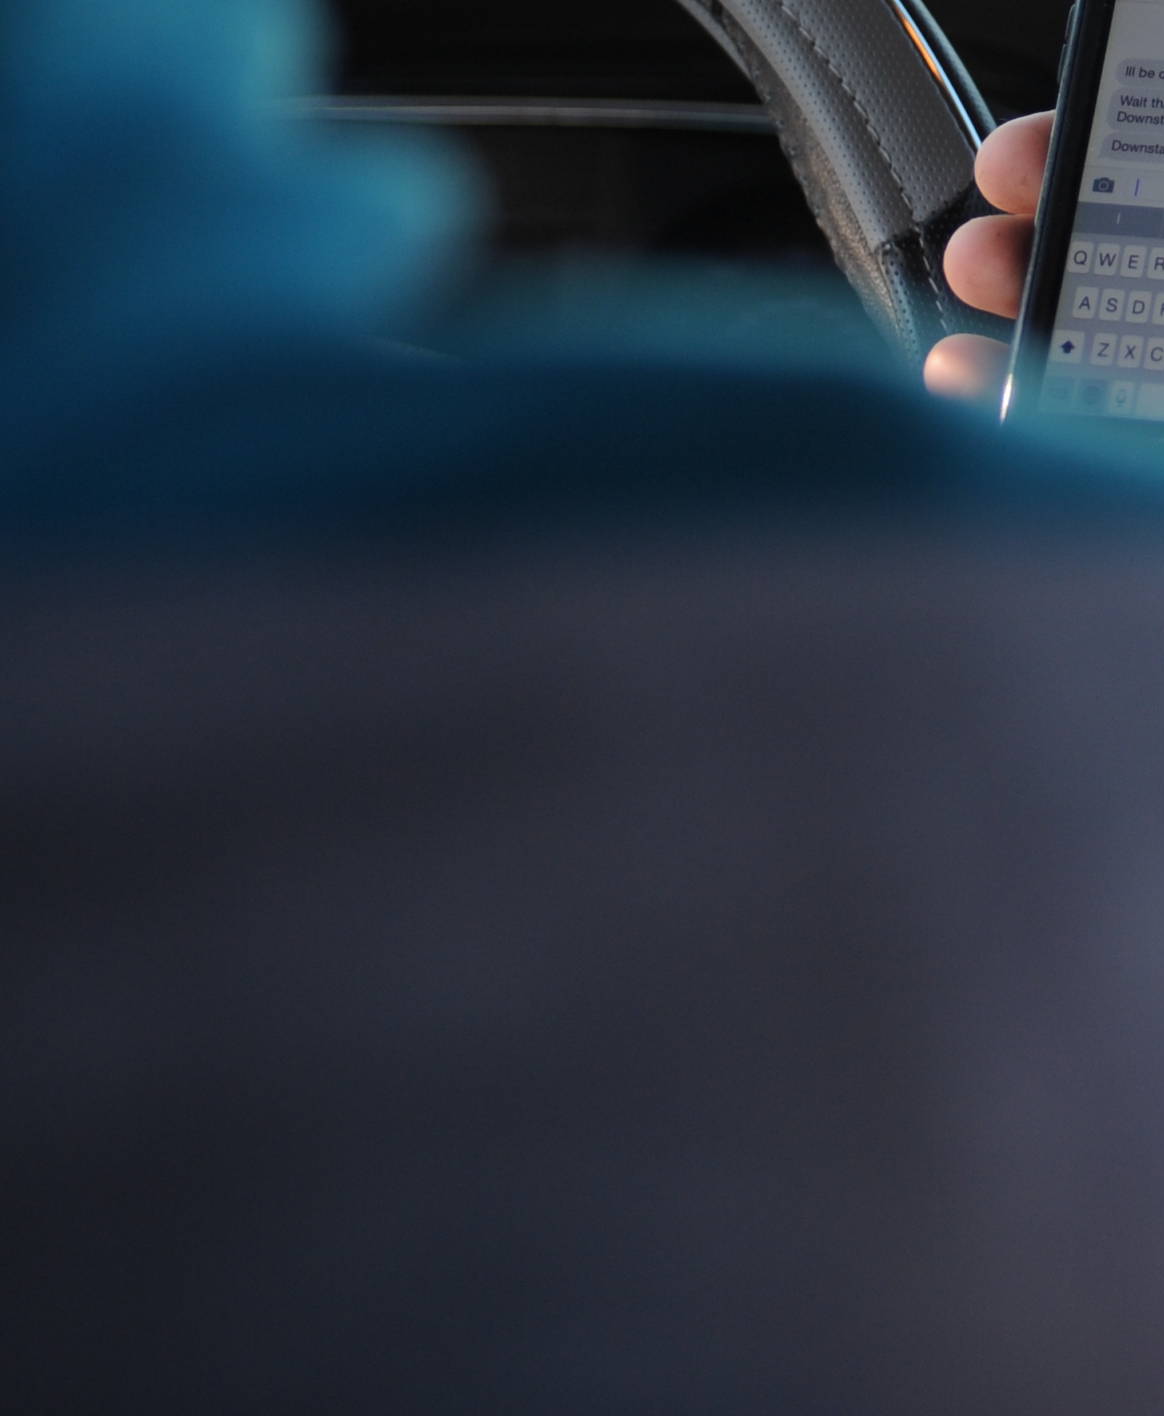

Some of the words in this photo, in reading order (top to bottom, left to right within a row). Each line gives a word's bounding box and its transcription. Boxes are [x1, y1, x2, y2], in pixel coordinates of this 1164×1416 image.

[1138, 68, 1156, 79] be
[1119, 95, 1148, 108] Wait
[1073, 249, 1088, 267] Q
[1098, 251, 1117, 268] W
[1127, 254, 1139, 270] E
[1078, 295, 1091, 311] A
[1105, 297, 1118, 313] S
[1132, 299, 1145, 315] D
[1097, 342, 1110, 357] Z
[1124, 344, 1137, 360] X
[1150, 347, 1164, 362] C
